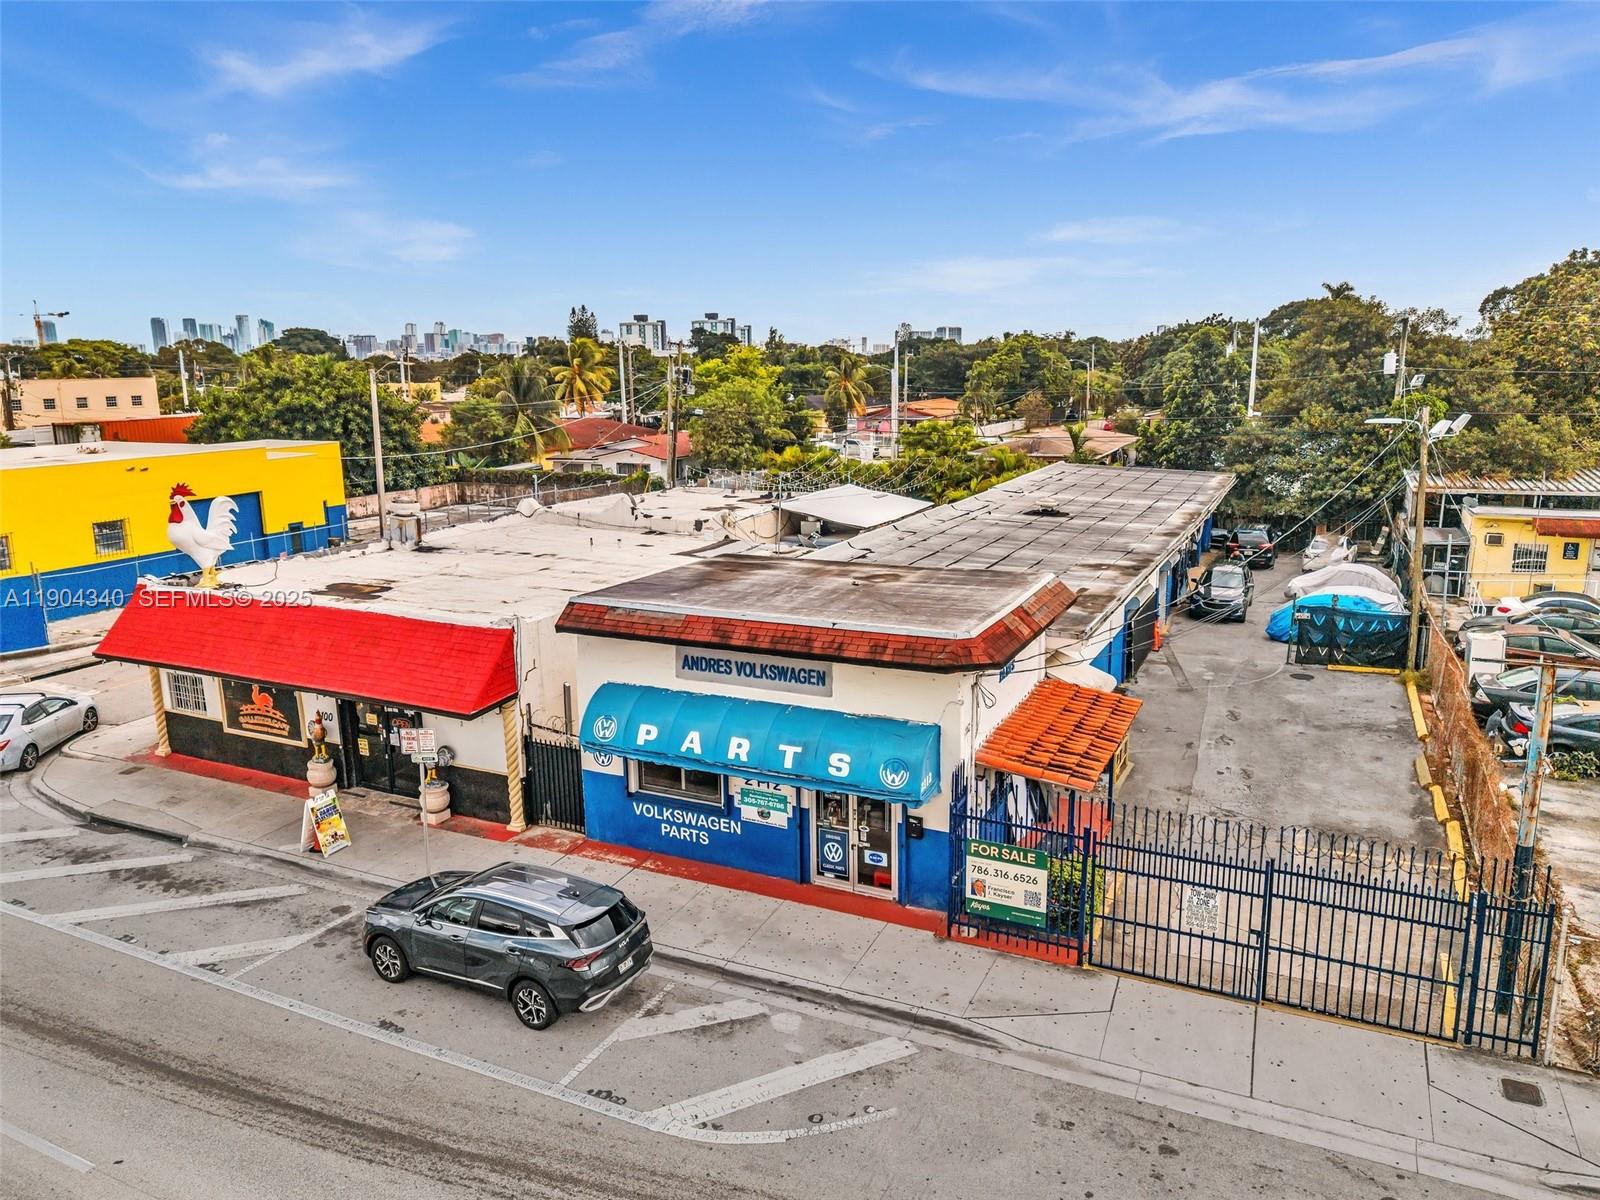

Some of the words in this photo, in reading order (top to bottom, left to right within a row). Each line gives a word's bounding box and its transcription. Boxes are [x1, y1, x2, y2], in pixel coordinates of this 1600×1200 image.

[682, 655, 733, 676] ANDRES
[734, 661, 826, 687] VOLKSWAGEN
[636, 723, 851, 778] PARTS
[632, 802, 742, 835] VOLKSWAGEN
[661, 823, 710, 845] PARTS
[970, 842, 999, 858] FOR
[1001, 848, 1037, 865] SALE
[971, 864, 1039, 886] 786.316.6526
[987, 885, 1016, 896] Francisco
[1190, 888, 1217, 899] TOW-AWAY
[1195, 897, 1211, 908] ZONE
